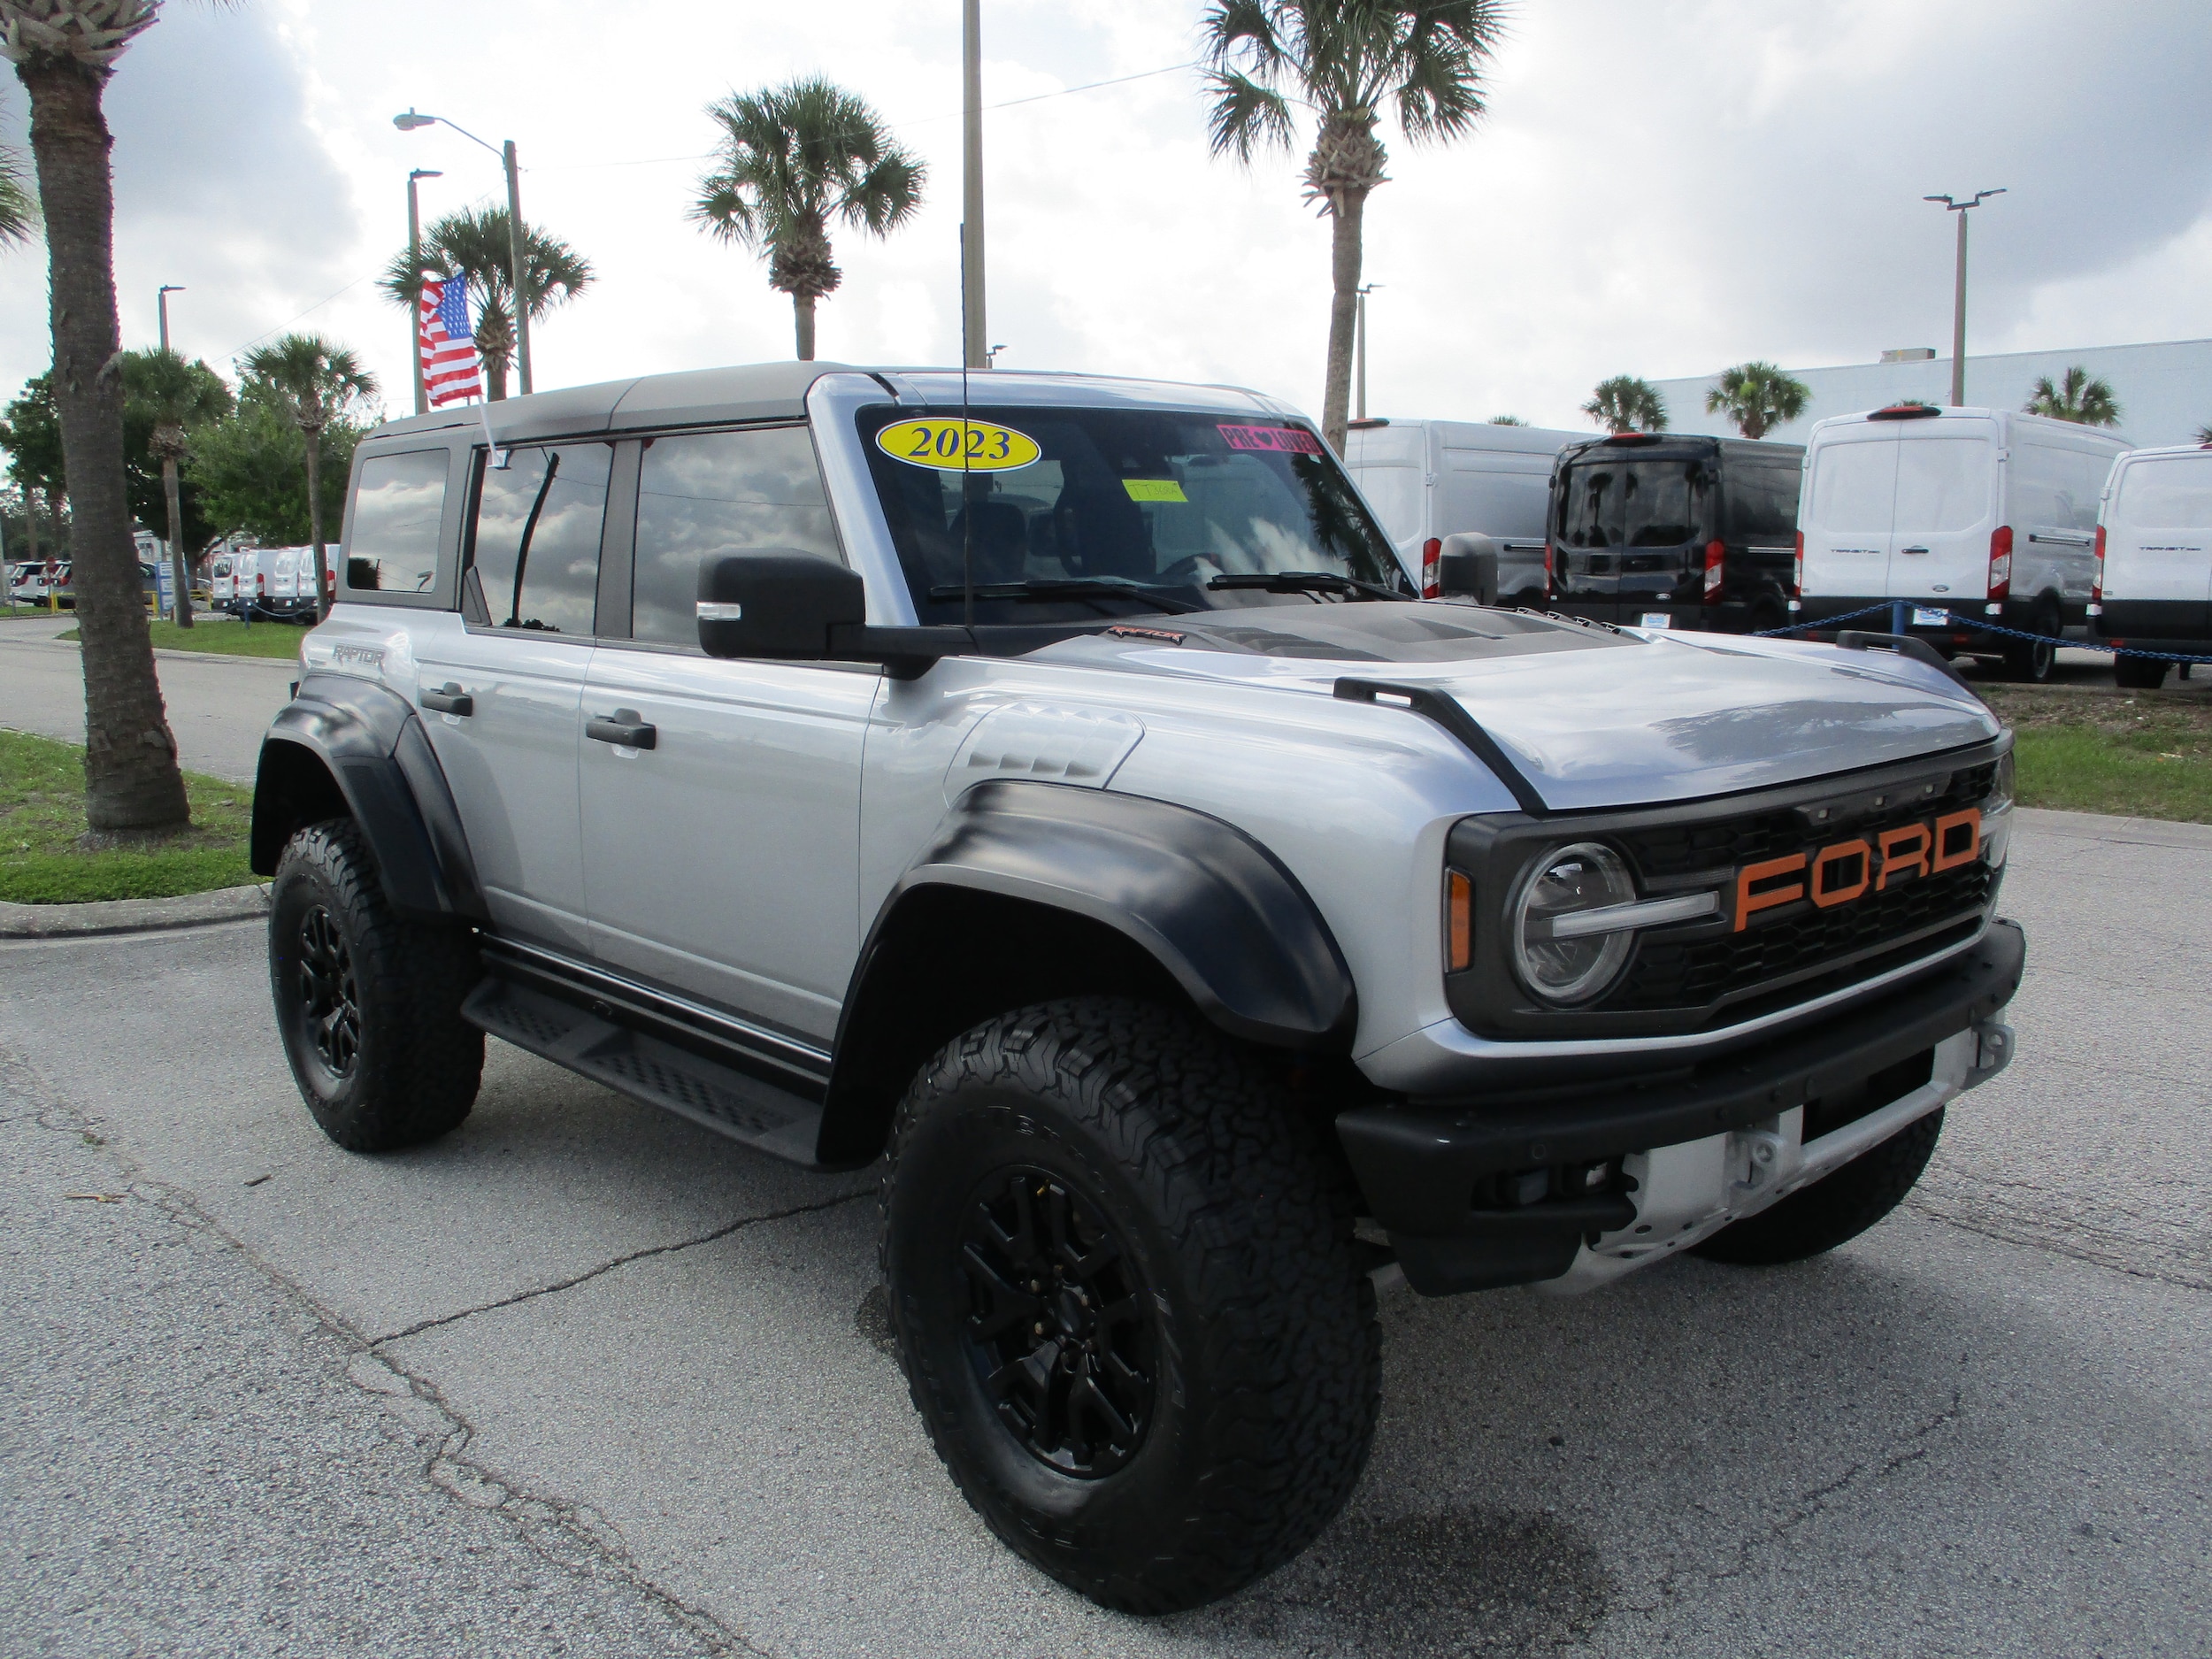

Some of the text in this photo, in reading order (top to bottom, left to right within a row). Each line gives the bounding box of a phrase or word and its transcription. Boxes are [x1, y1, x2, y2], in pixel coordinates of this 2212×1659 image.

[909, 427, 1010, 460] 2023
[1220, 427, 1320, 454] PRE LOVED
[333, 643, 387, 672] RAPTOR
[1734, 807, 1981, 933] FORD
